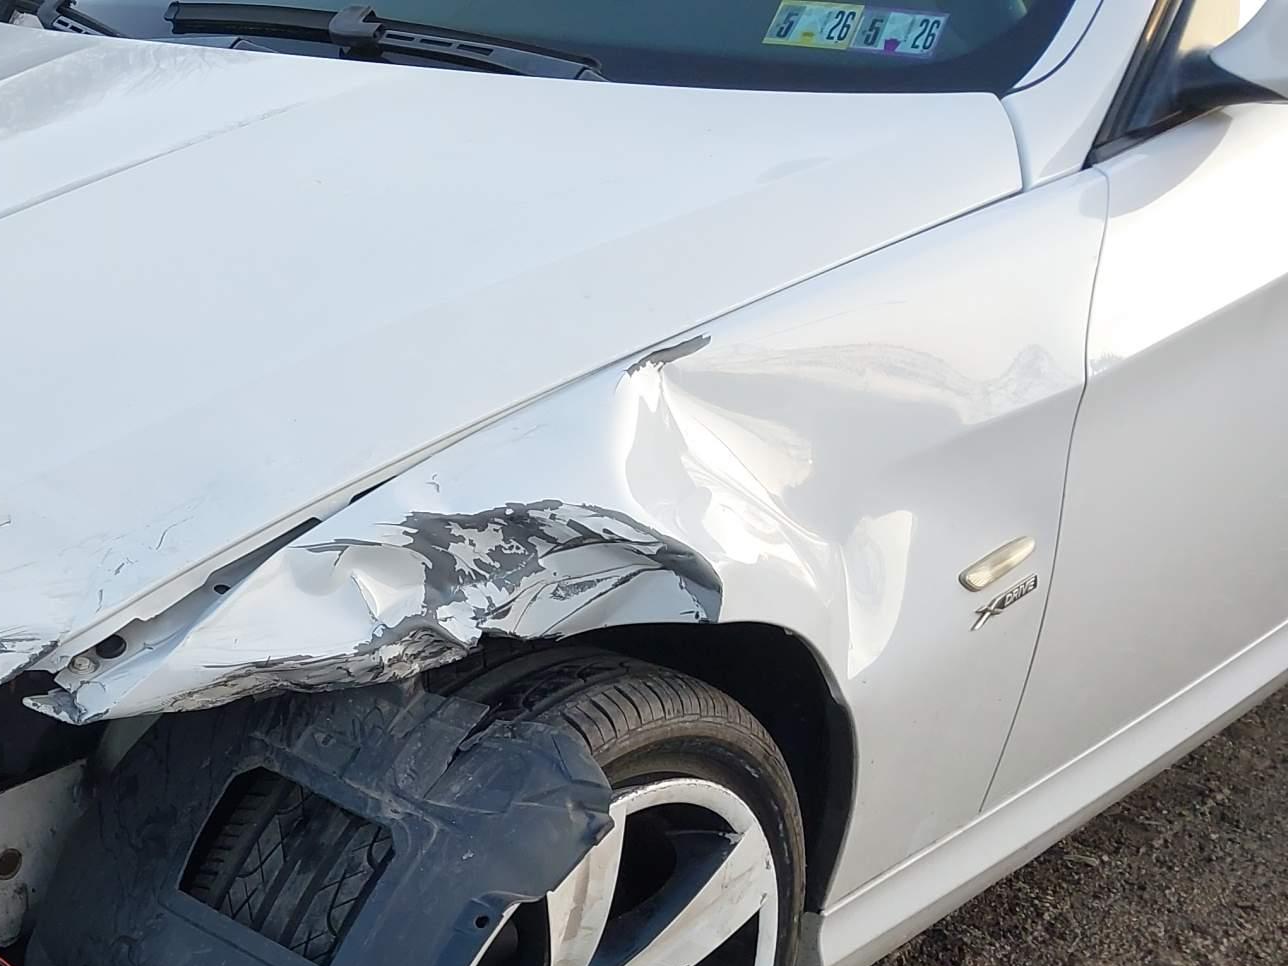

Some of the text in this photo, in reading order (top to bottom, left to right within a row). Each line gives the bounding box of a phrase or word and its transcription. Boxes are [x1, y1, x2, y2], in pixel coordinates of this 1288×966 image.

[776, 13, 800, 39] 5
[825, 10, 857, 42] 26
[863, 18, 884, 46] 5
[910, 18, 942, 50] 26
